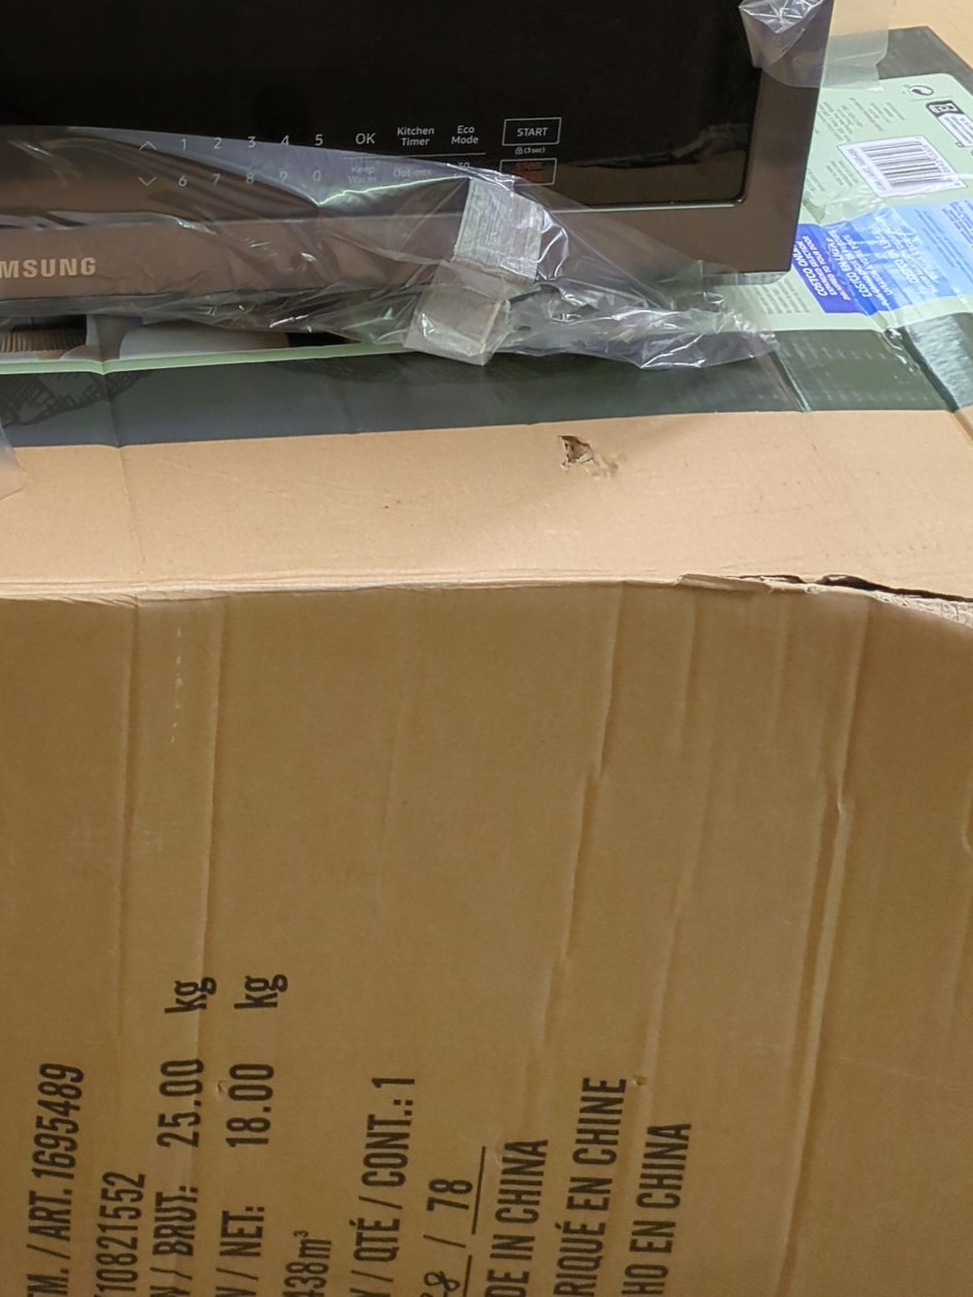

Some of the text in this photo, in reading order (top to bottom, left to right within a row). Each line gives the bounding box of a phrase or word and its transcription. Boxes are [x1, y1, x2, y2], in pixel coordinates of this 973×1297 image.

[355, 133, 376, 144] OK
[397, 127, 435, 136] Kitchen
[457, 124, 475, 134] Eco
[516, 127, 548, 137] START
[181, 138, 187, 150] 1
[213, 137, 222, 149] 2
[247, 136, 256, 148] 3
[280, 135, 289, 146] 4
[315, 134, 323, 146] 5
[401, 137, 430, 146] Timer
[451, 135, 479, 145] Mode
[212, 173, 221, 185] 7
[245, 172, 254, 184] 8
[313, 170, 321, 182] 0
[351, 165, 375, 175] Keep
[179, 175, 187, 187] 6
[803, 268, 828, 296] COSTCO
[846, 271, 872, 298] COSTCO
[164, 976, 217, 1013] kg
[233, 974, 288, 1009] kg
[156, 1059, 205, 1148] 25.00
[225, 1063, 274, 1147] 18.00
[31, 1063, 84, 1180] 1695489
[495, 1139, 548, 1224] CHINA
[553, 1077, 627, 1297] RIQUÉ EN CHINE
[427, 1178, 473, 1211] 78
[28, 1188, 73, 1242] ART.
[622, 1123, 691, 1296] HO EN CHINA
[152, 1186, 198, 1256] BRUT:
[219, 1206, 265, 1257] NET:
[349, 1218, 400, 1262] QTÉ
[490, 1234, 535, 1260] IN
